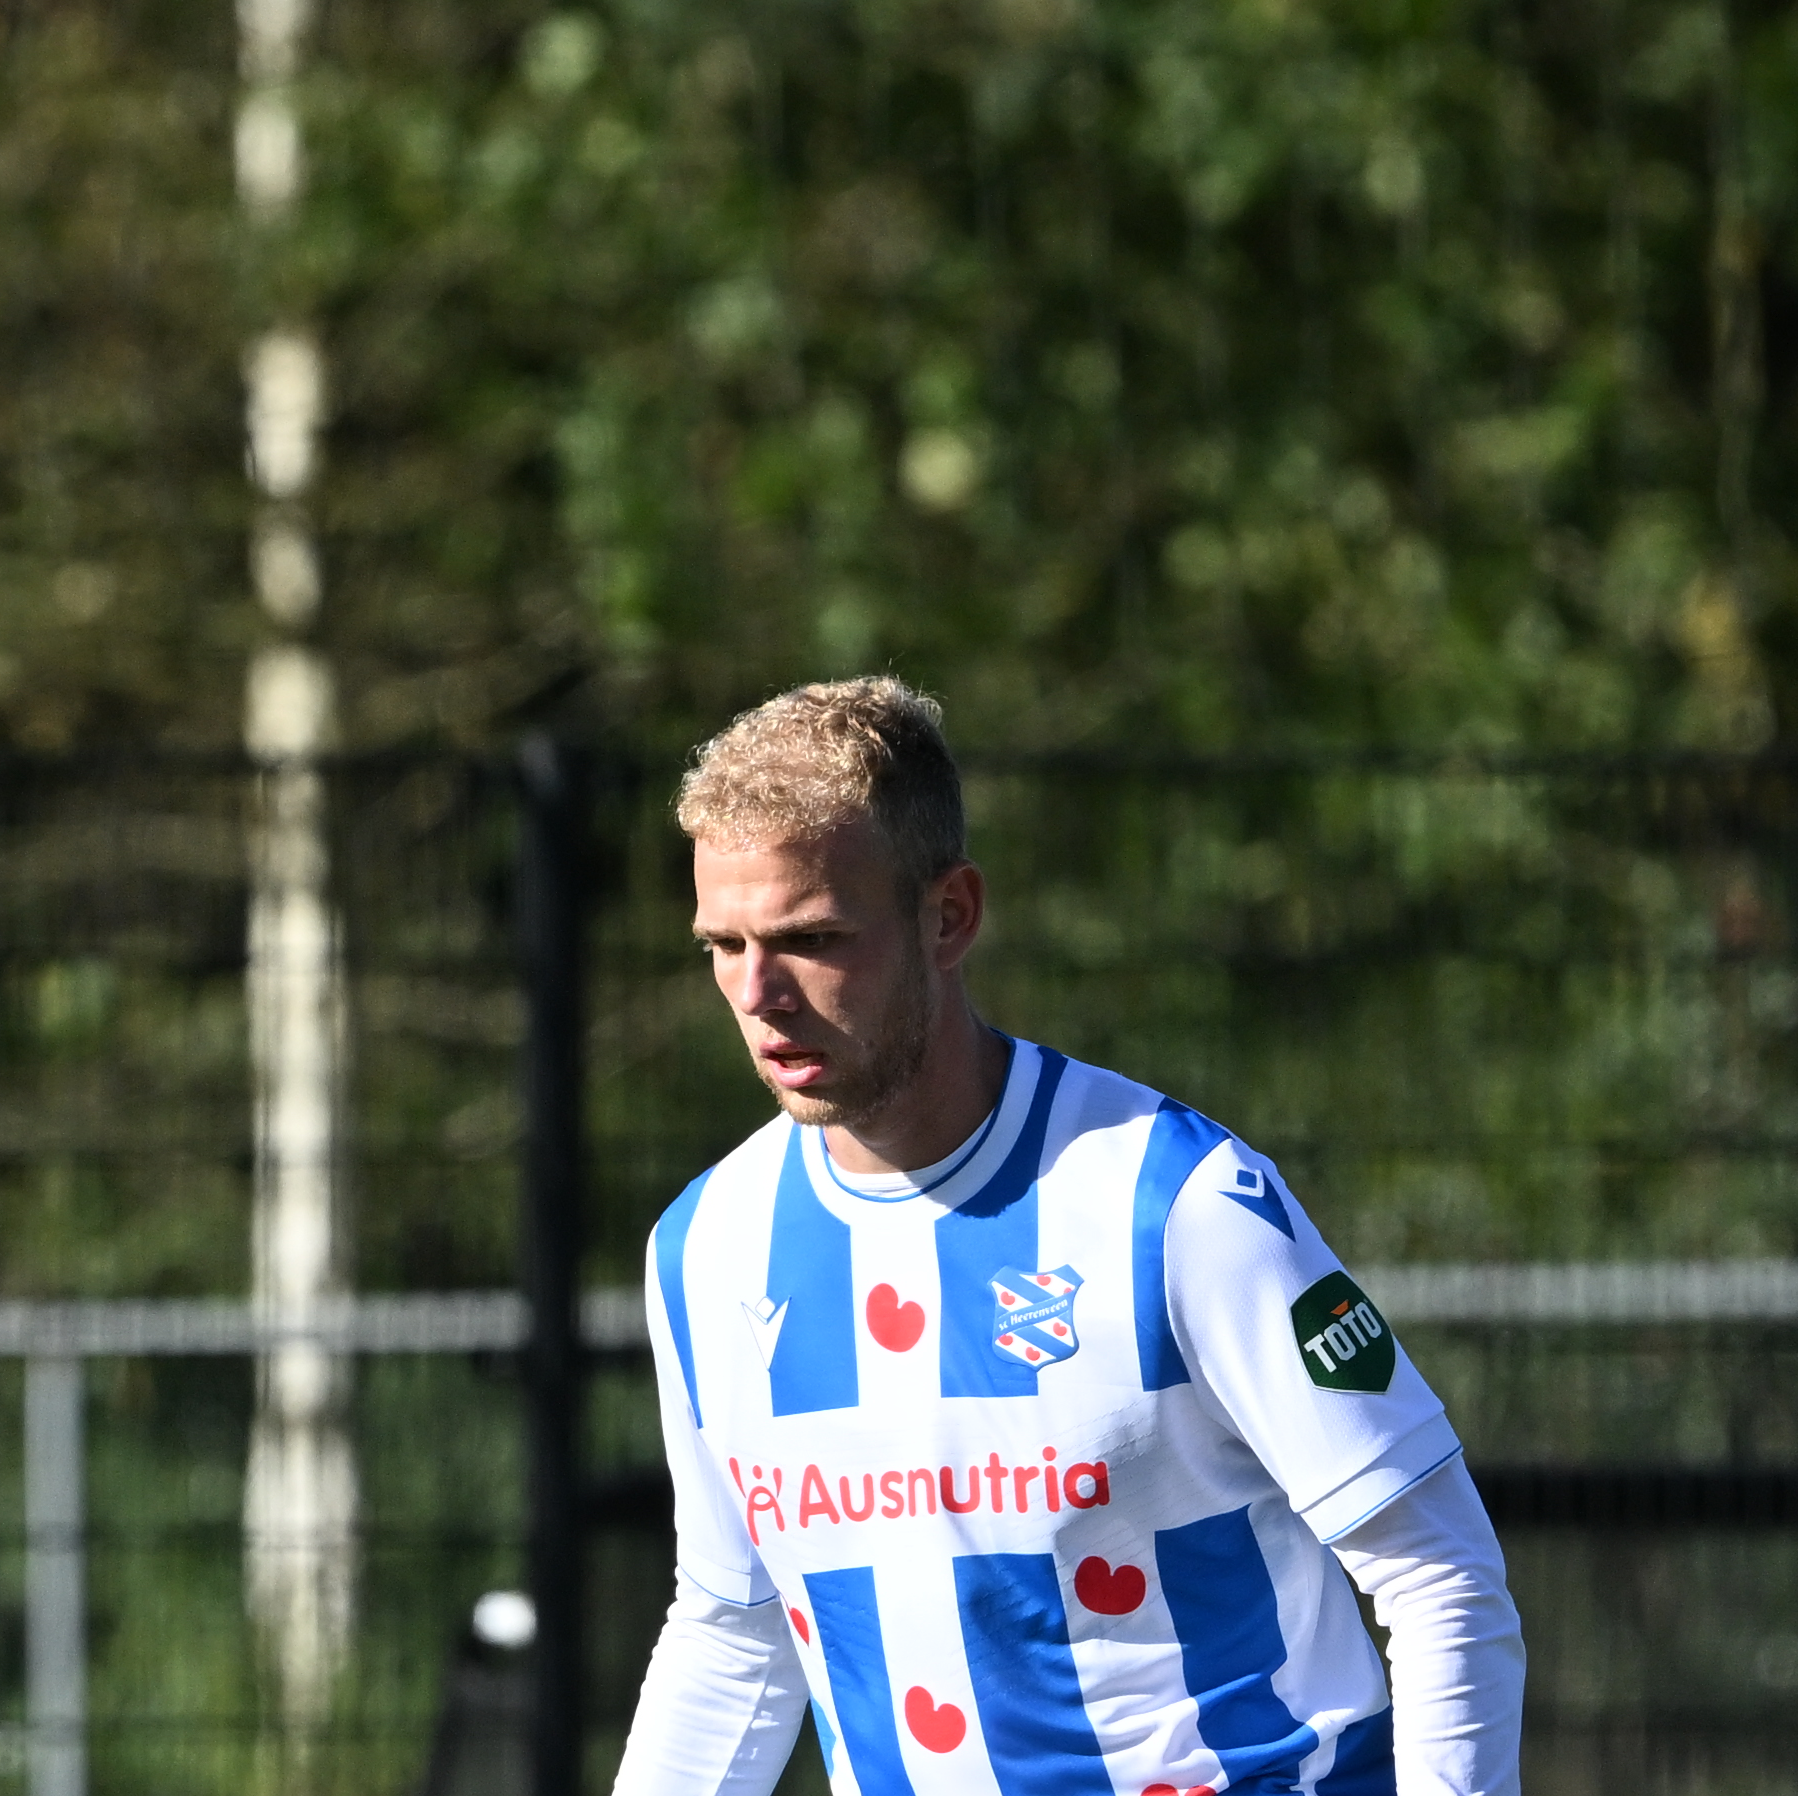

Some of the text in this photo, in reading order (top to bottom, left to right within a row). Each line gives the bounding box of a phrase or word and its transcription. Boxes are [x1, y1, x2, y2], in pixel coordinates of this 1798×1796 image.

[1010, 1298, 1068, 1326] Heerenveen
[1303, 1301, 1382, 1373] TOTO
[798, 1446, 1111, 1530] Ausnutria
